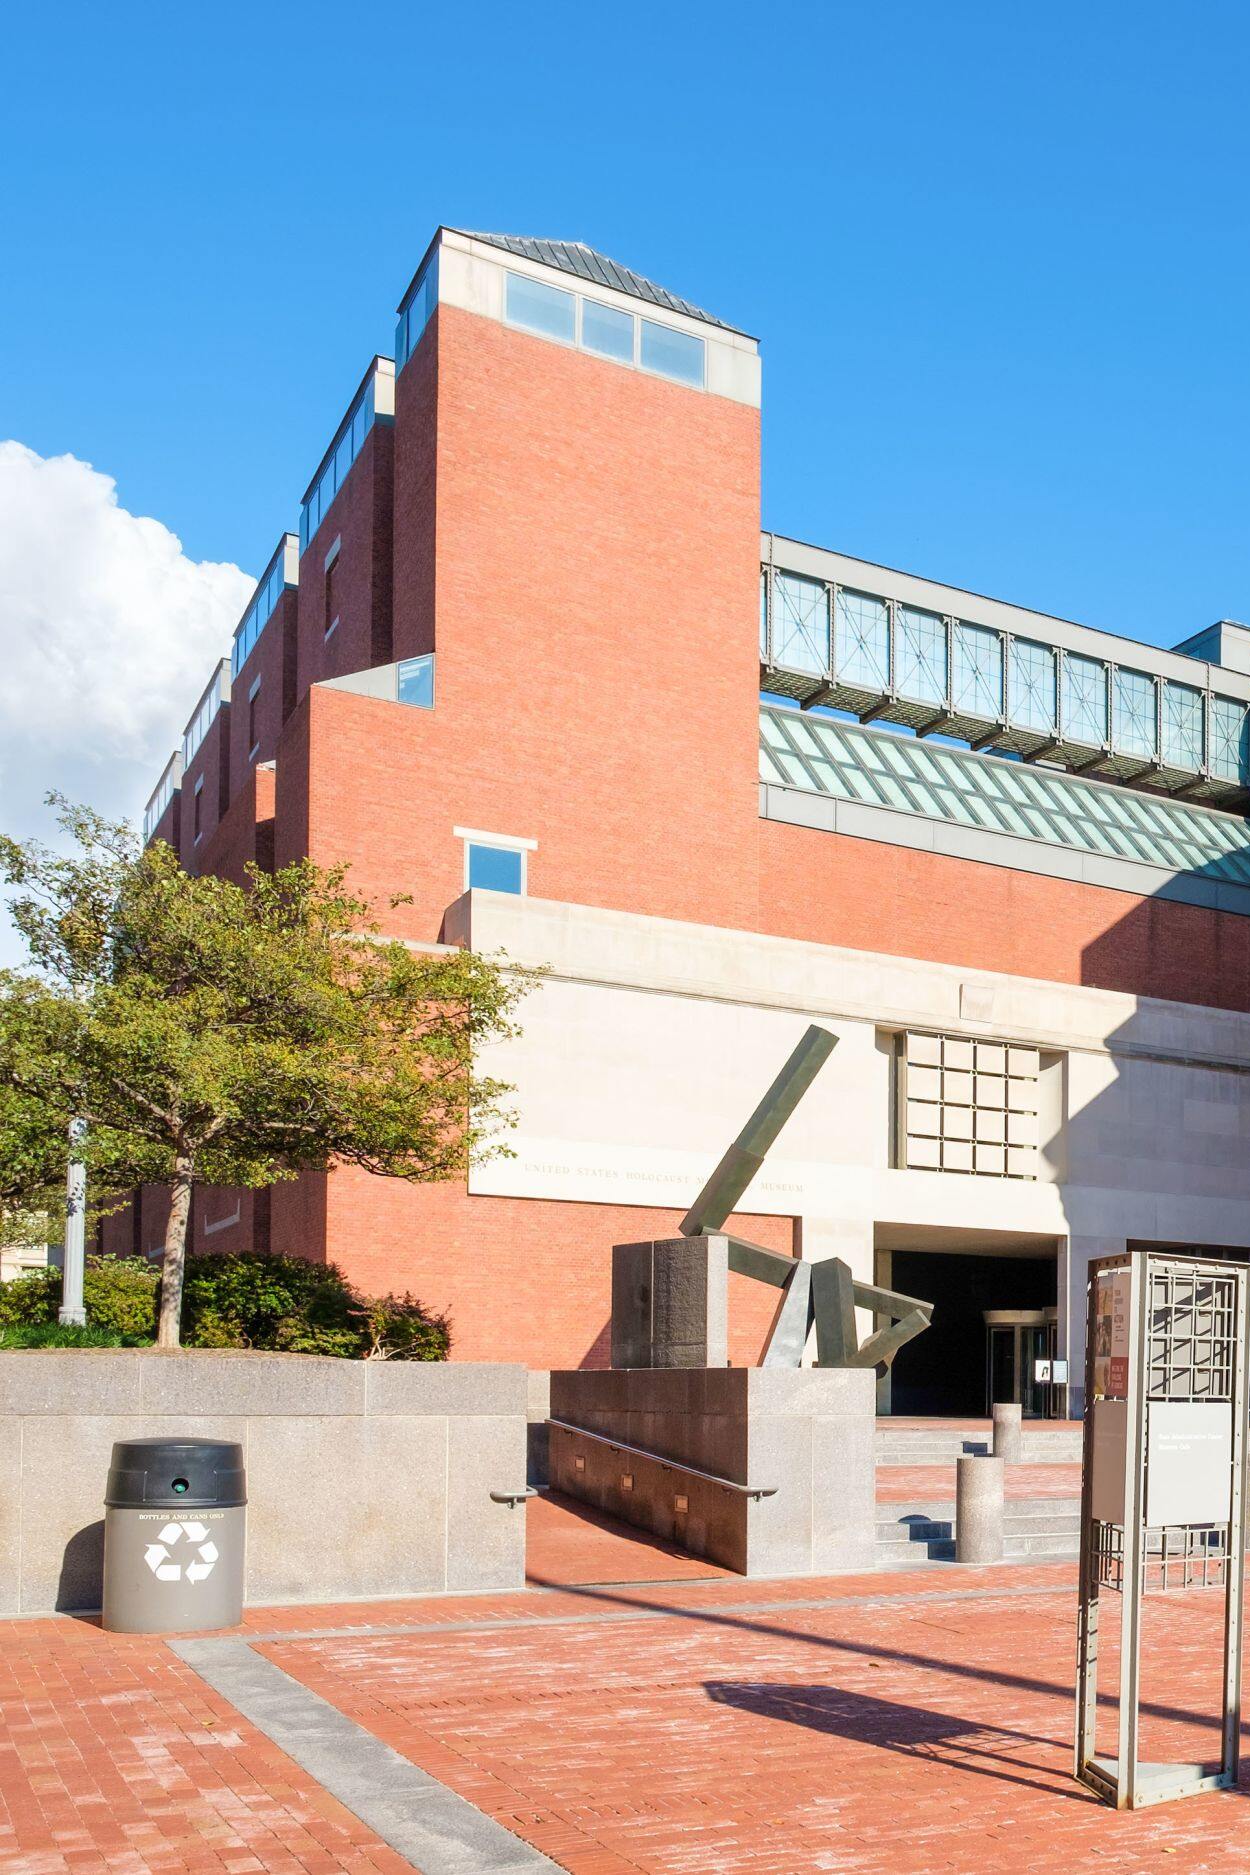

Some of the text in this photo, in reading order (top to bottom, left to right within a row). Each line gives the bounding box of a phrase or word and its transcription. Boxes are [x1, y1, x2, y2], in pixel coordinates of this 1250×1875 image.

[524, 1163, 570, 1175] UNITED
[576, 1167, 619, 1179] STATES
[625, 1171, 689, 1184] HOLOCAUST
[760, 1182, 805, 1193] MUSEUM
